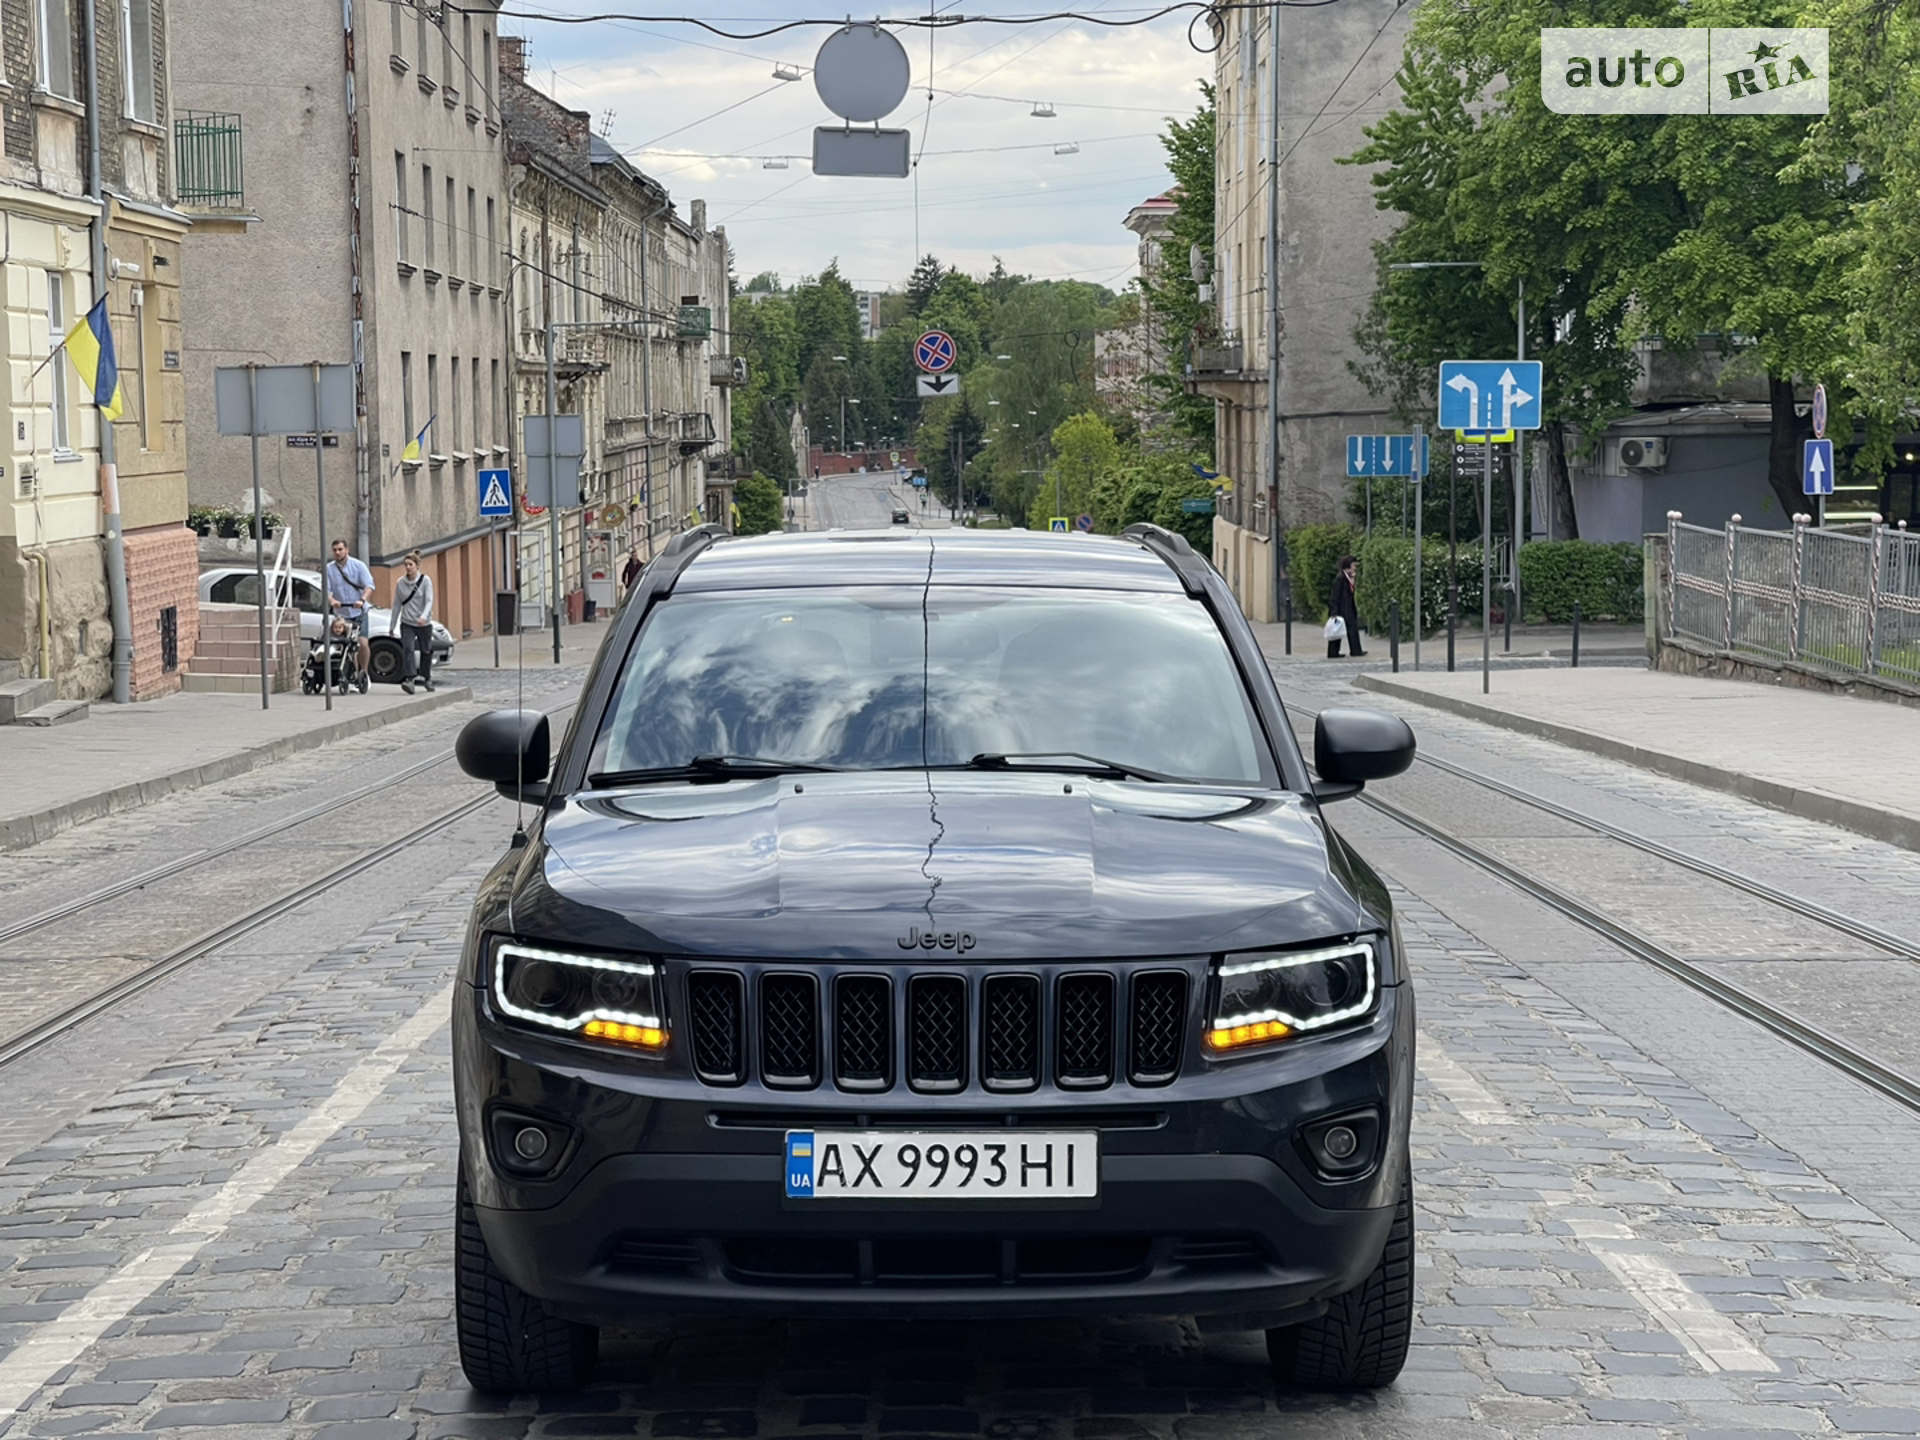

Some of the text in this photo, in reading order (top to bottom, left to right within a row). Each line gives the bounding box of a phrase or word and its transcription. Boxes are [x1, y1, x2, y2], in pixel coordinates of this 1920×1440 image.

[898, 926, 977, 954] Jeep
[817, 1144, 1074, 1188] AX 9993 HI
[791, 1173, 811, 1188] UA
